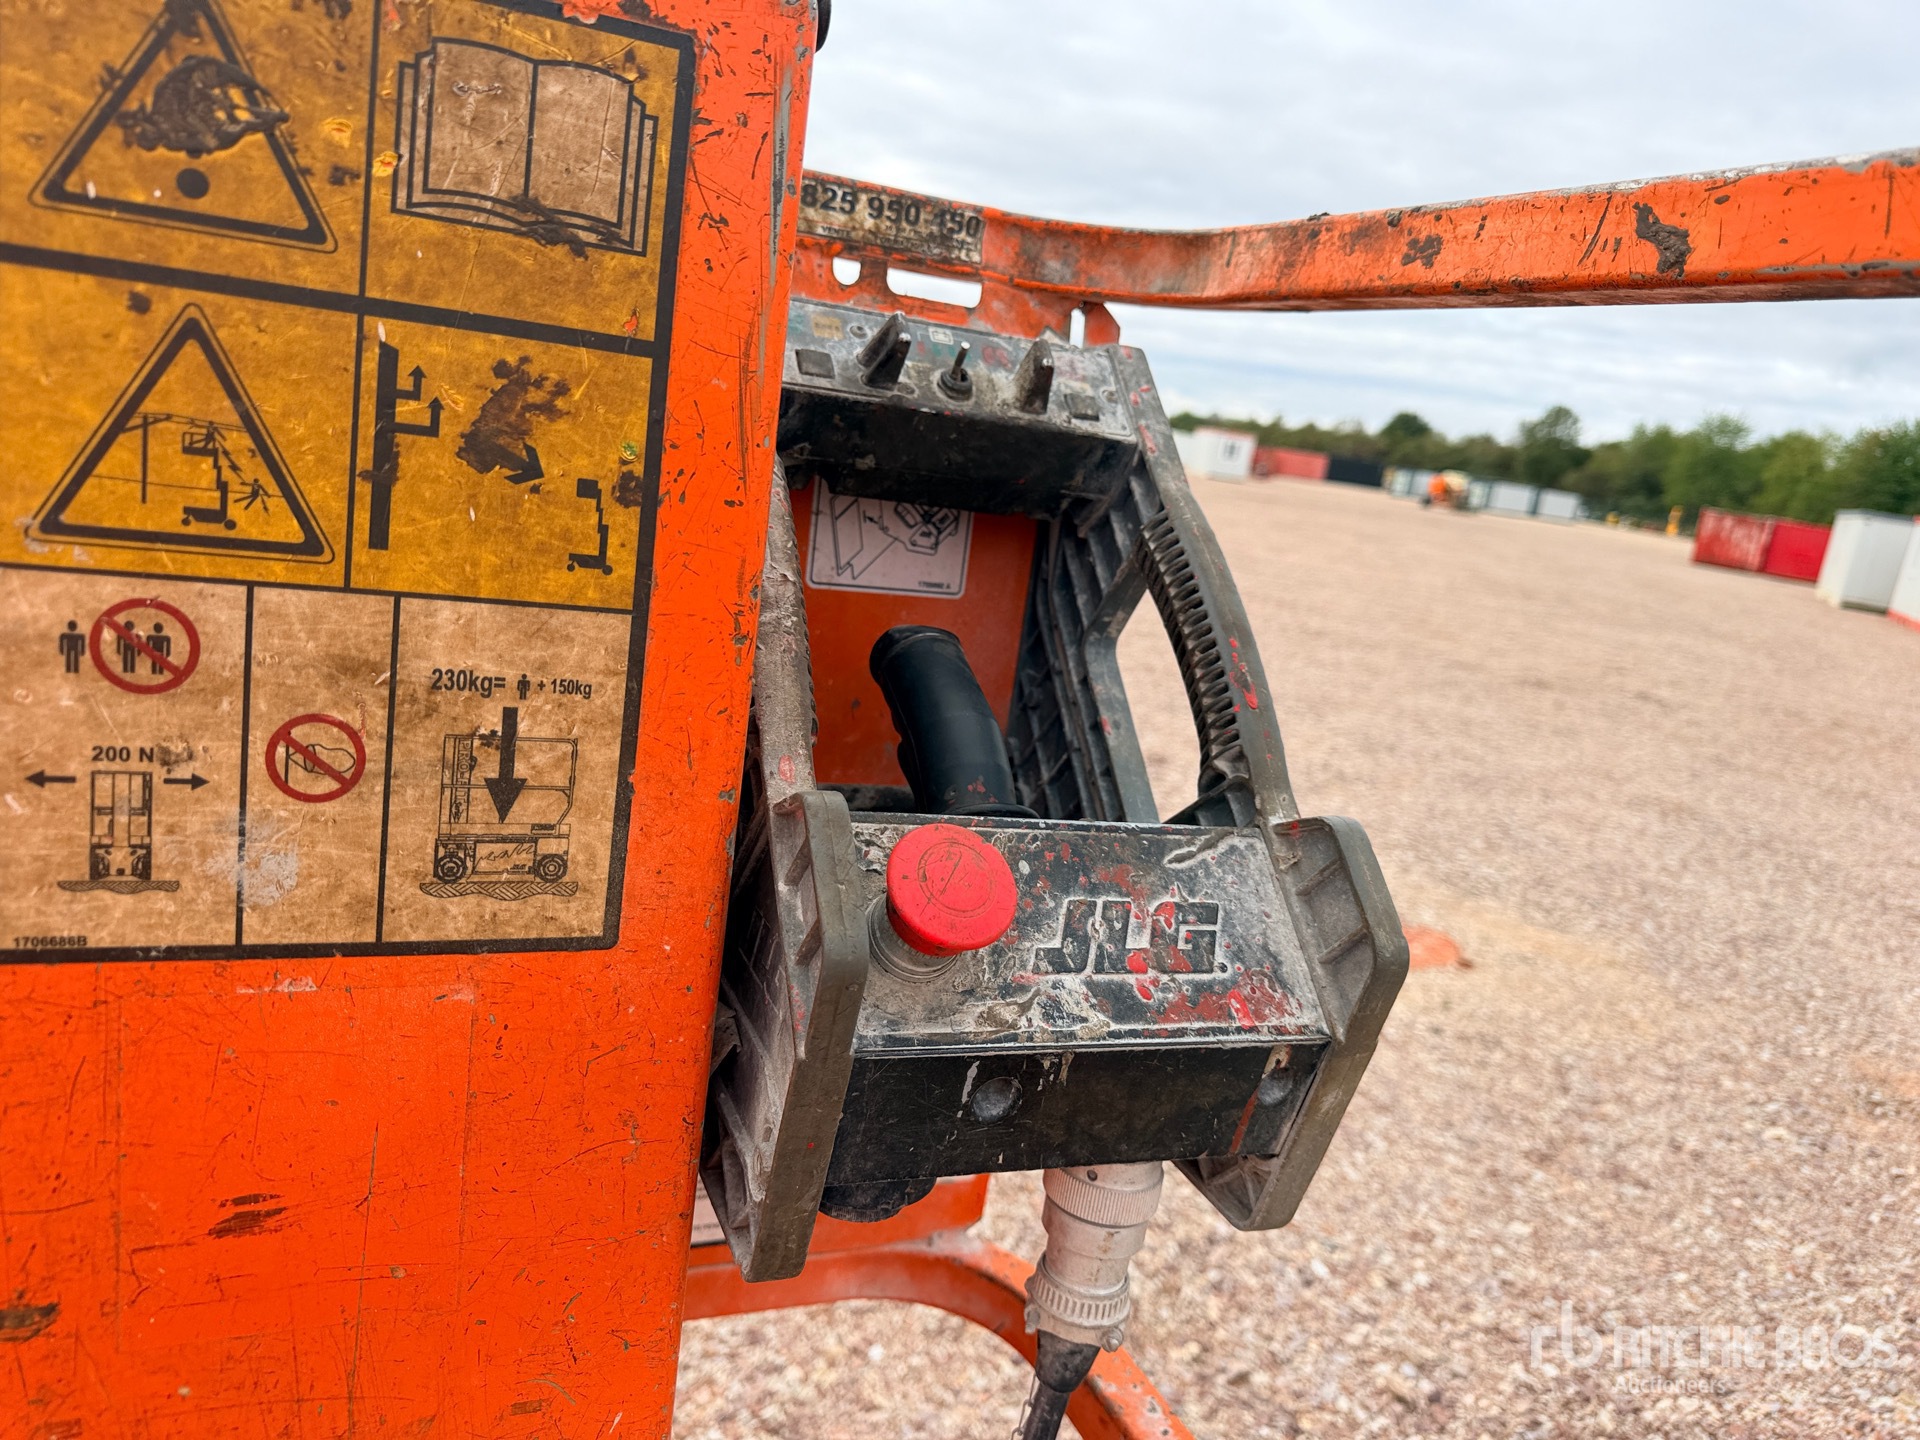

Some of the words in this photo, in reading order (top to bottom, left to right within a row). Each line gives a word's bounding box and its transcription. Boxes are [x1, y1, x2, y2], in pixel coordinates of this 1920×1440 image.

[868, 196, 921, 227] 950
[550, 678, 592, 699] 150kg
[91, 745, 131, 762] 200
[1032, 898, 1220, 975] JLG
